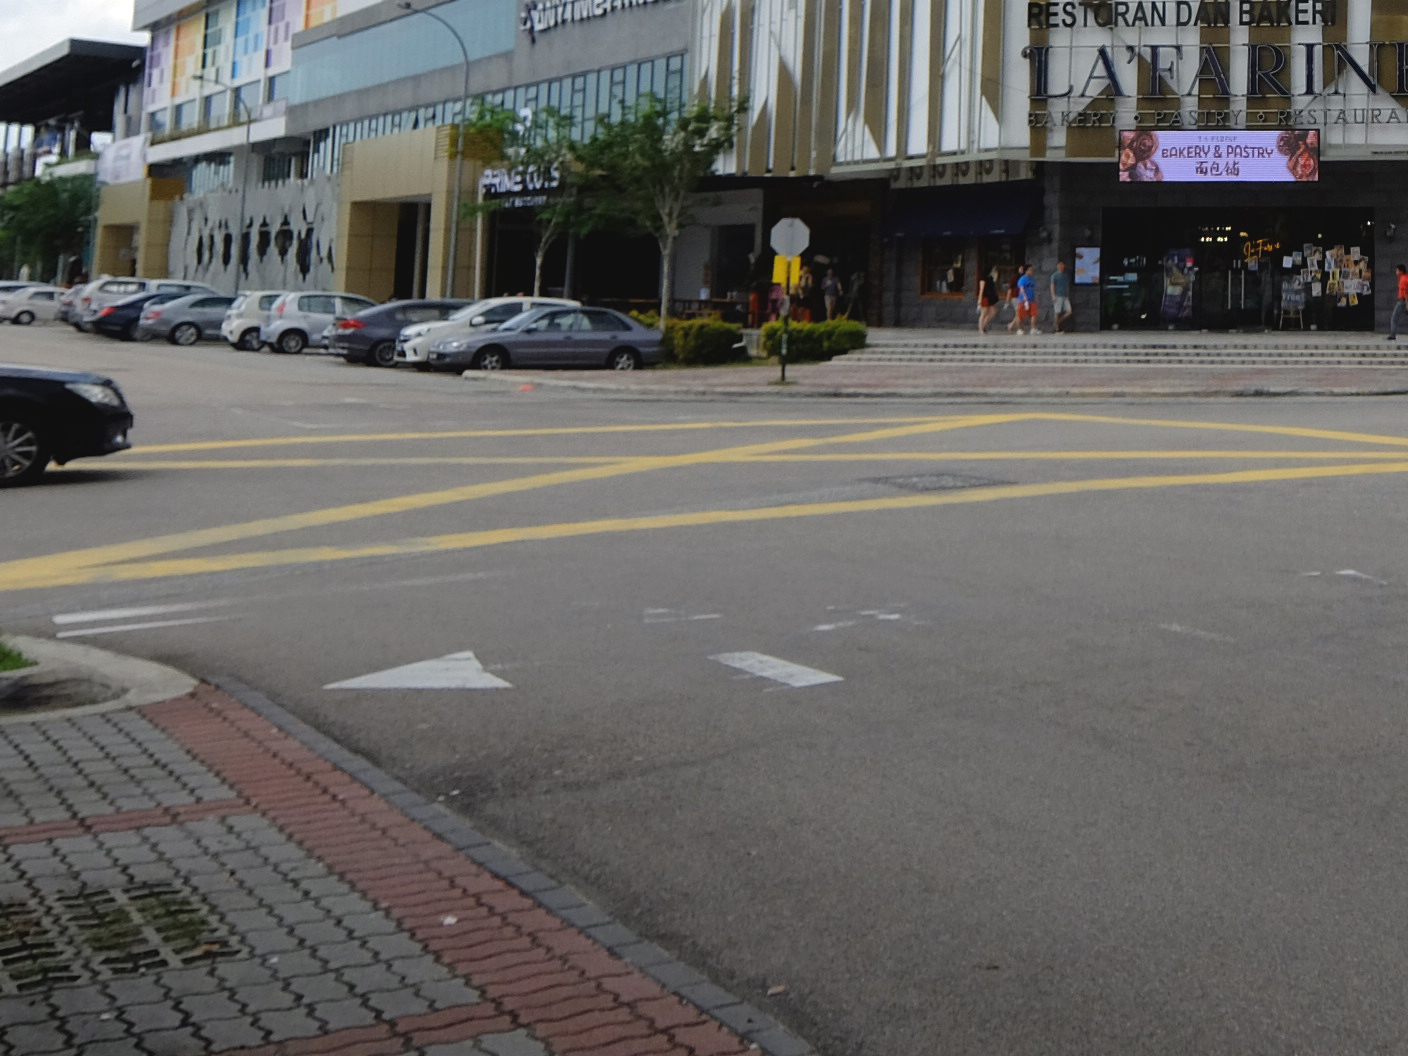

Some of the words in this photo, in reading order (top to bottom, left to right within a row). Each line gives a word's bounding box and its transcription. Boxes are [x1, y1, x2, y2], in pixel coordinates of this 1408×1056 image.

[1027, 1, 1167, 29] RESTORAN
[1176, 0, 1230, 27] DAN
[1027, 110, 1117, 127] BAKERY
[1154, 109, 1242, 127] PASTRY
[1161, 145, 1211, 158] BAKERY
[1213, 145, 1222, 158] &
[1226, 145, 1274, 158] PASTRY
